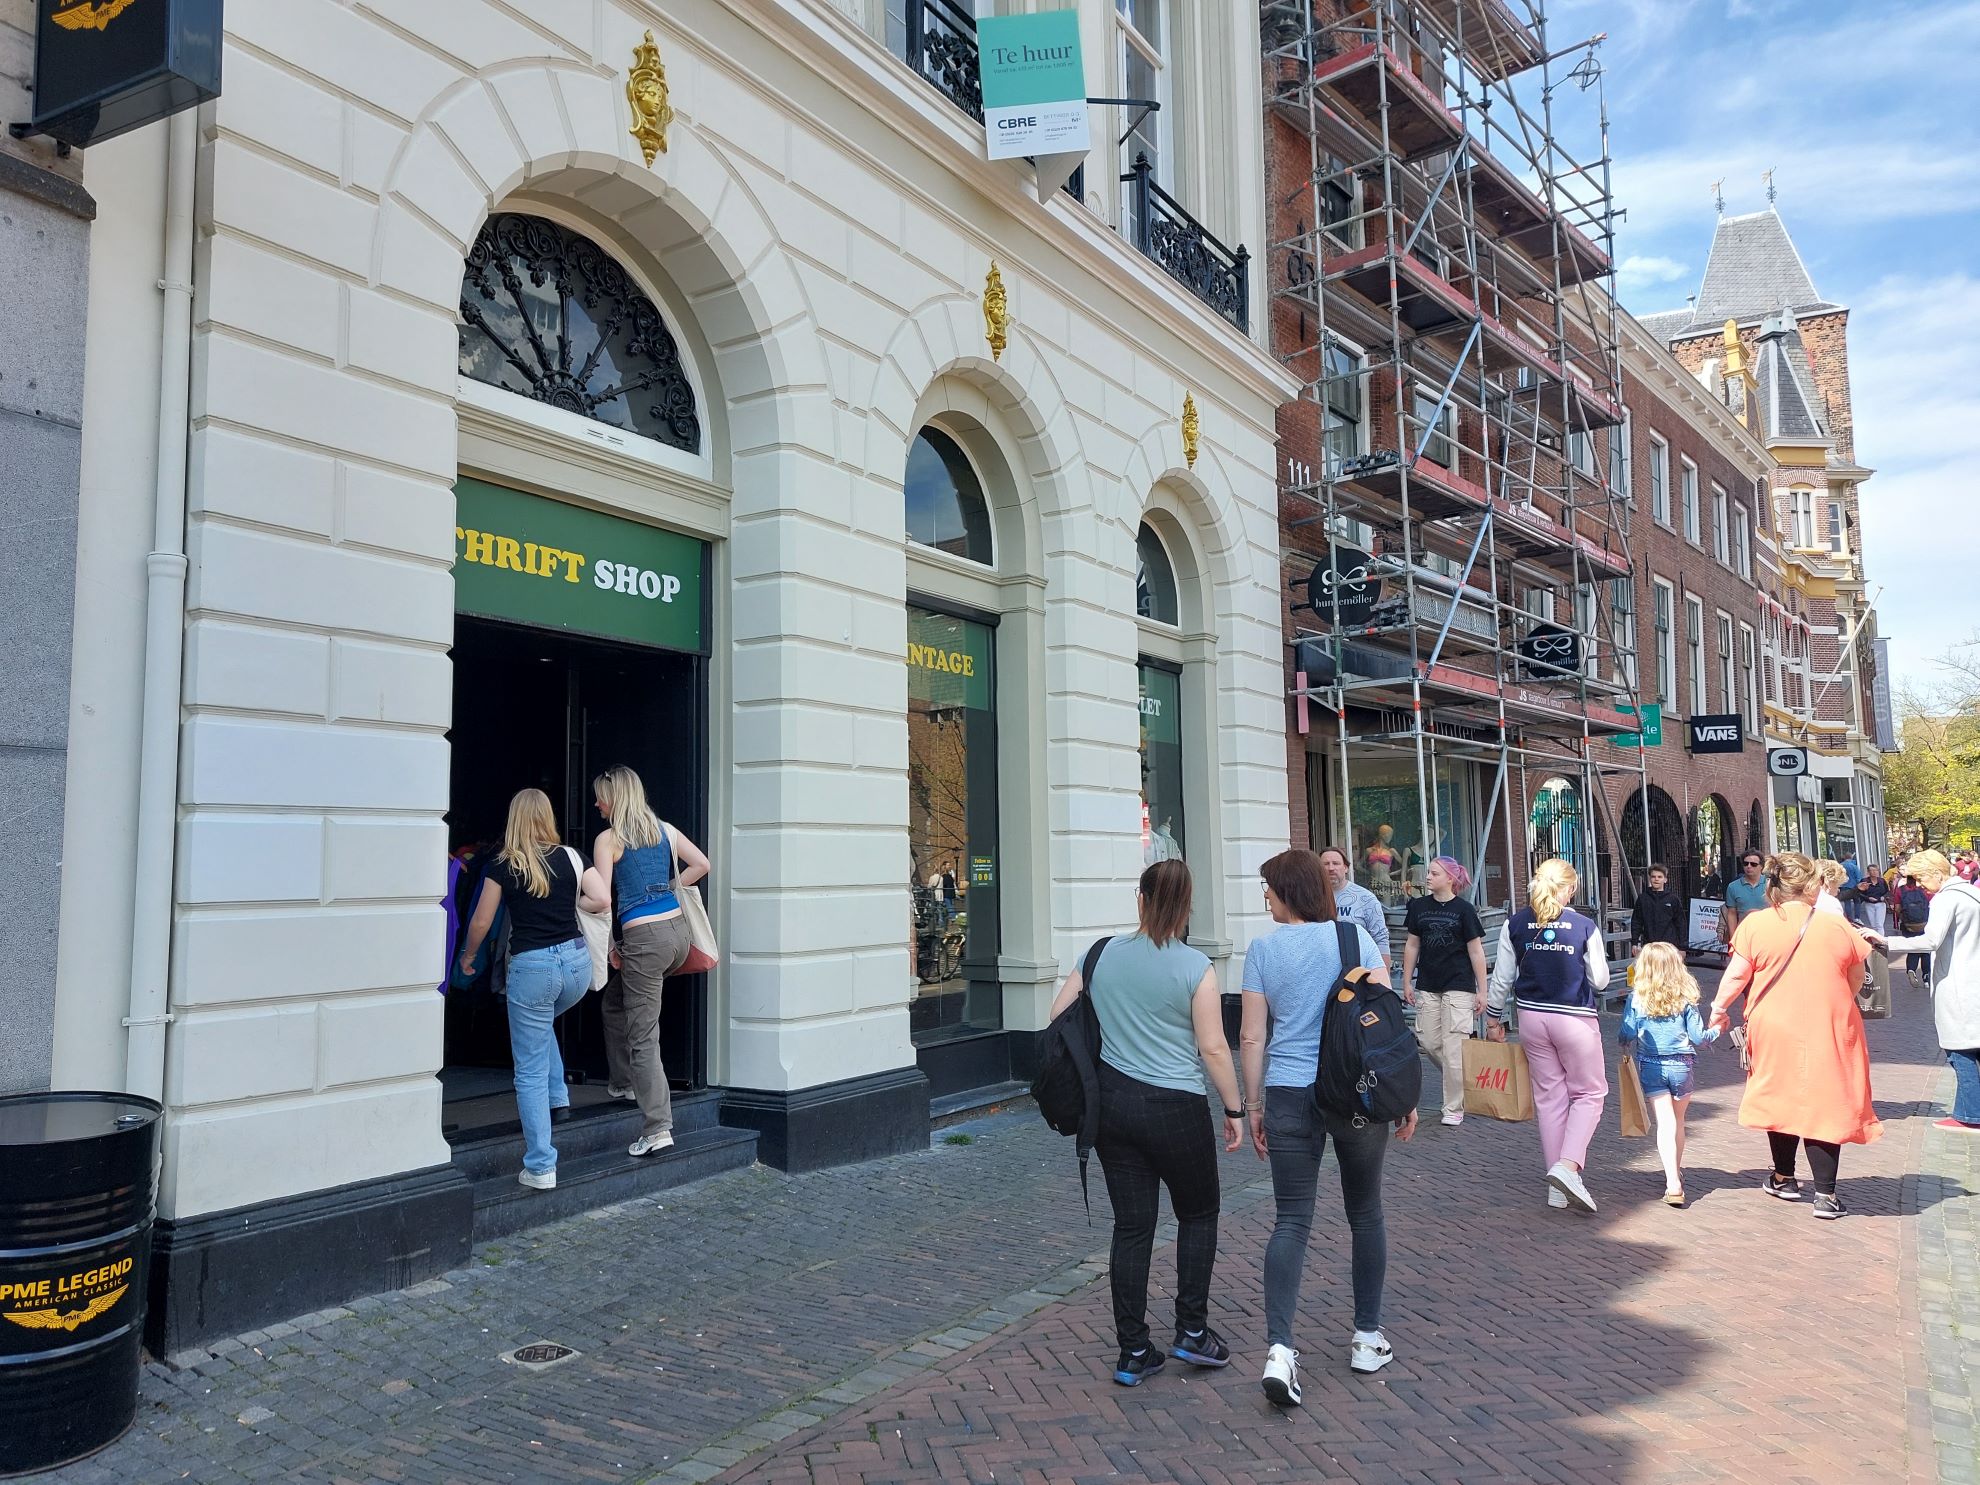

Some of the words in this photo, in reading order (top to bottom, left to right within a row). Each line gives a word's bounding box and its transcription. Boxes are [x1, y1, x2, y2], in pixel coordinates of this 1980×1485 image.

[991, 47, 1018, 65] Te
[1022, 44, 1073, 62] huur
[998, 116, 1037, 130] CBRE
[1288, 457, 1310, 486] 111
[1509, 504, 1517, 516] JS
[594, 559, 681, 603] SHOP
[1315, 594, 1374, 609] hunemöller
[1530, 656, 1579, 669] hunemöller
[1519, 689, 1528, 702] JS
[1695, 725, 1738, 742] VANS
[1699, 904, 1720, 914] VANS
[1475, 1066, 1509, 1092] H&M
[0, 1279, 51, 1300] PME
[58, 1257, 133, 1293] LEGEND
[15, 1292, 78, 1309] AMERICAN
[83, 1277, 123, 1296] CLASSIC
[63, 1313, 81, 1323] PME
